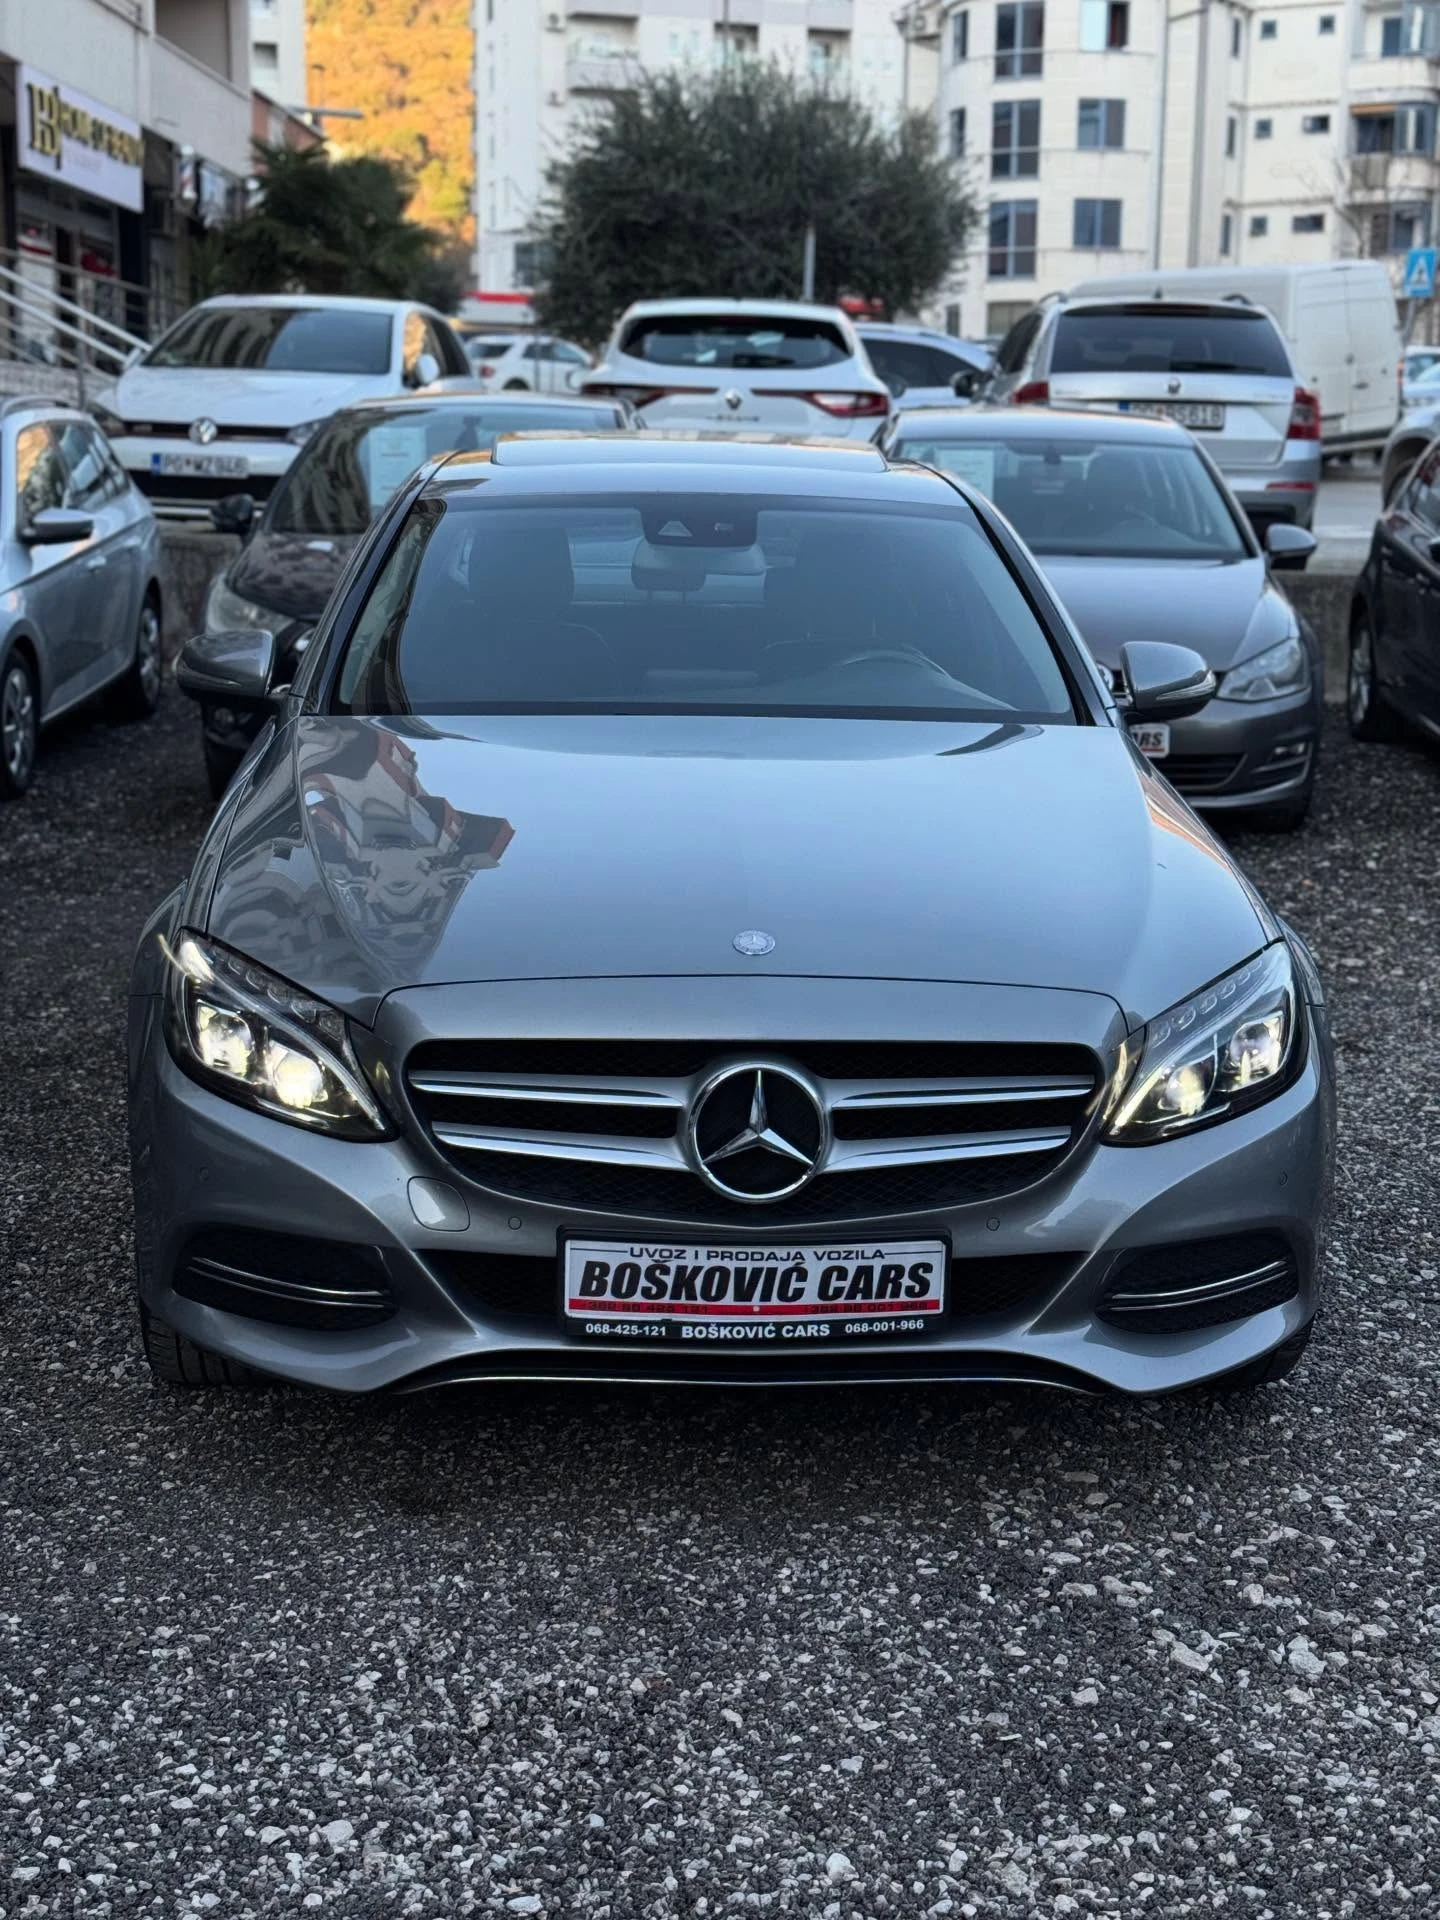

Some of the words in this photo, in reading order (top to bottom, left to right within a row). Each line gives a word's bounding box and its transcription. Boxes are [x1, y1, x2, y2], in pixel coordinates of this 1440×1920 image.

[630, 1247, 687, 1260] UVOZ
[694, 1250, 699, 1261] I
[706, 1249, 806, 1262] PRODAJA
[814, 1249, 886, 1261] VOZILA
[579, 1259, 809, 1303] BOŠKOVIĆ
[817, 1262, 934, 1302] CARS
[585, 1323, 667, 1336] 068-425-121
[681, 1323, 776, 1339] BOŠKOVIĆ
[782, 1323, 831, 1338] CARS
[845, 1319, 925, 1334] 068-001-966
